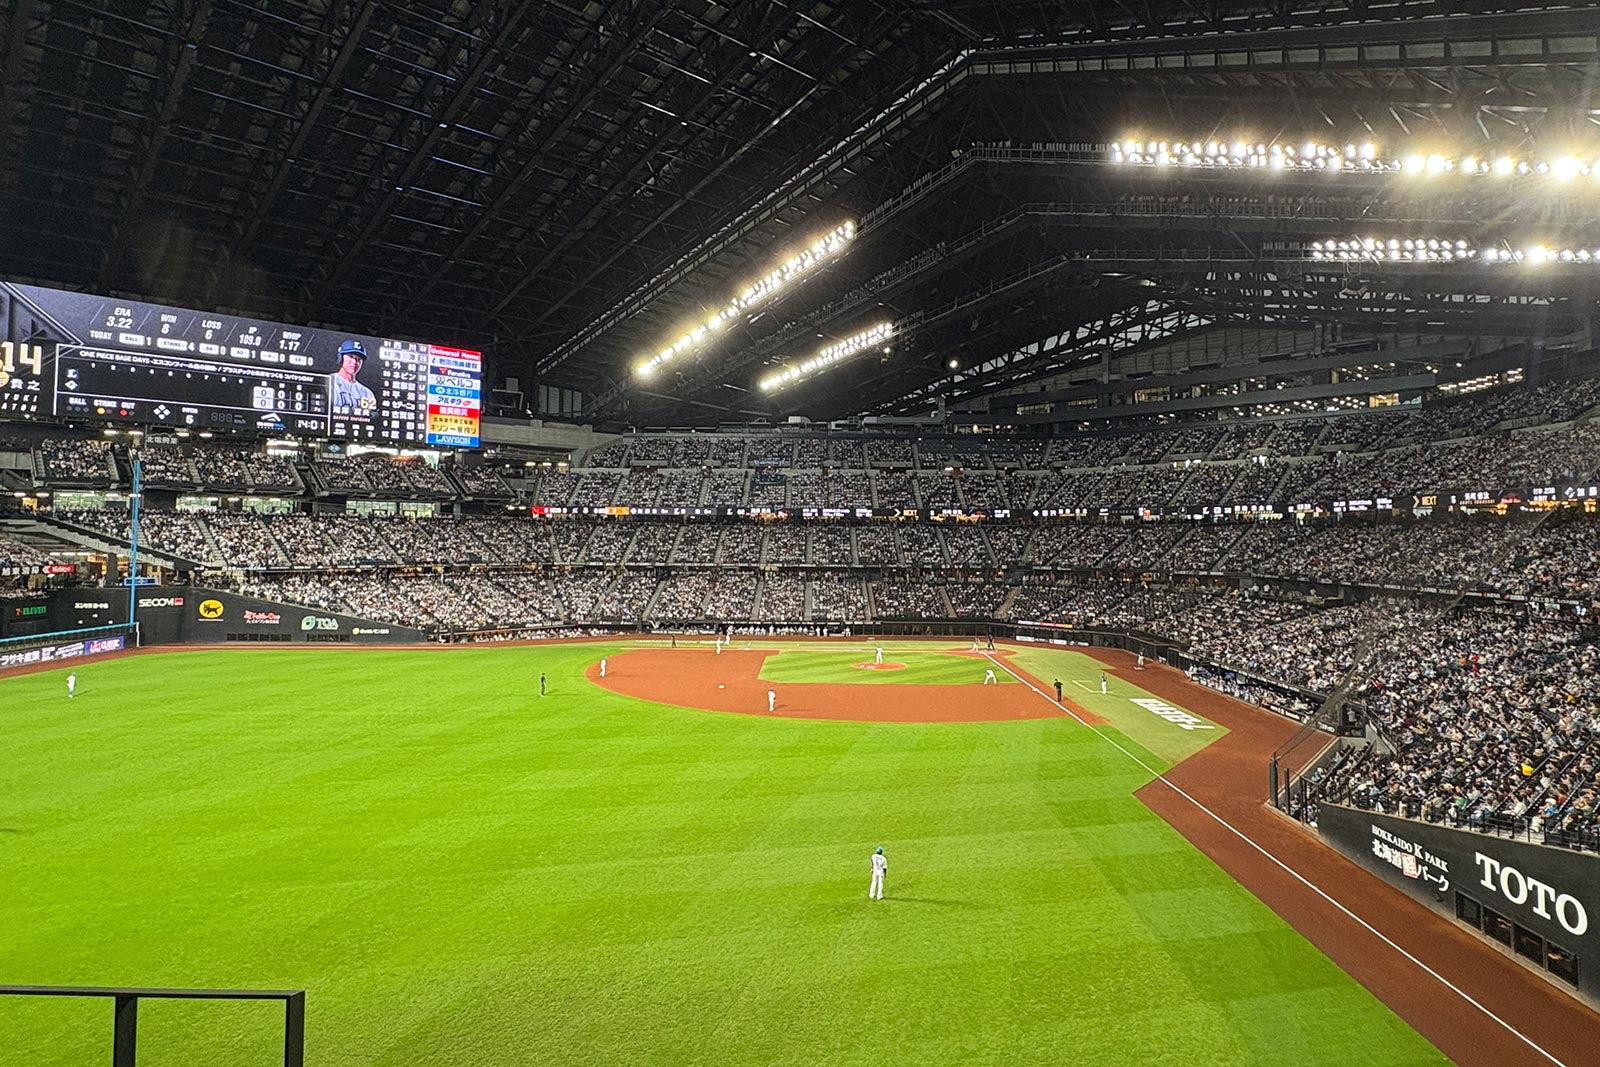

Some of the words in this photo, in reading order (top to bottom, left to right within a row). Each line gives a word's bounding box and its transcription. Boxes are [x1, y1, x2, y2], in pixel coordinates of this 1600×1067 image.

[114, 308, 131, 317] ERA
[106, 316, 132, 328] 3.22
[161, 314, 177, 323] WIN
[161, 324, 169, 334] 8
[202, 320, 222, 329] LOSS
[90, 330, 112, 339] TODAY
[205, 330, 213, 340] 6
[282, 331, 301, 340] WHIP
[239, 334, 261, 346] 109.0
[188, 342, 194, 351] 4
[280, 340, 300, 351] 1.17
[1, 342, 42, 375] 14
[447, 378, 473, 388] ベルコ
[295, 402, 302, 410] 0
[361, 397, 376, 410] 62
[436, 435, 470, 444] LAWSON
[1422, 496, 1437, 505] NEXT
[139, 598, 174, 607] SECOM
[316, 618, 339, 627] TOA
[0, 651, 40, 666] ラサキ産業
[1372, 824, 1412, 852] HOKKAIDO
[1414, 843, 1423, 859] K
[1425, 852, 1448, 872] PARK
[1476, 852, 1588, 935] TOTO
